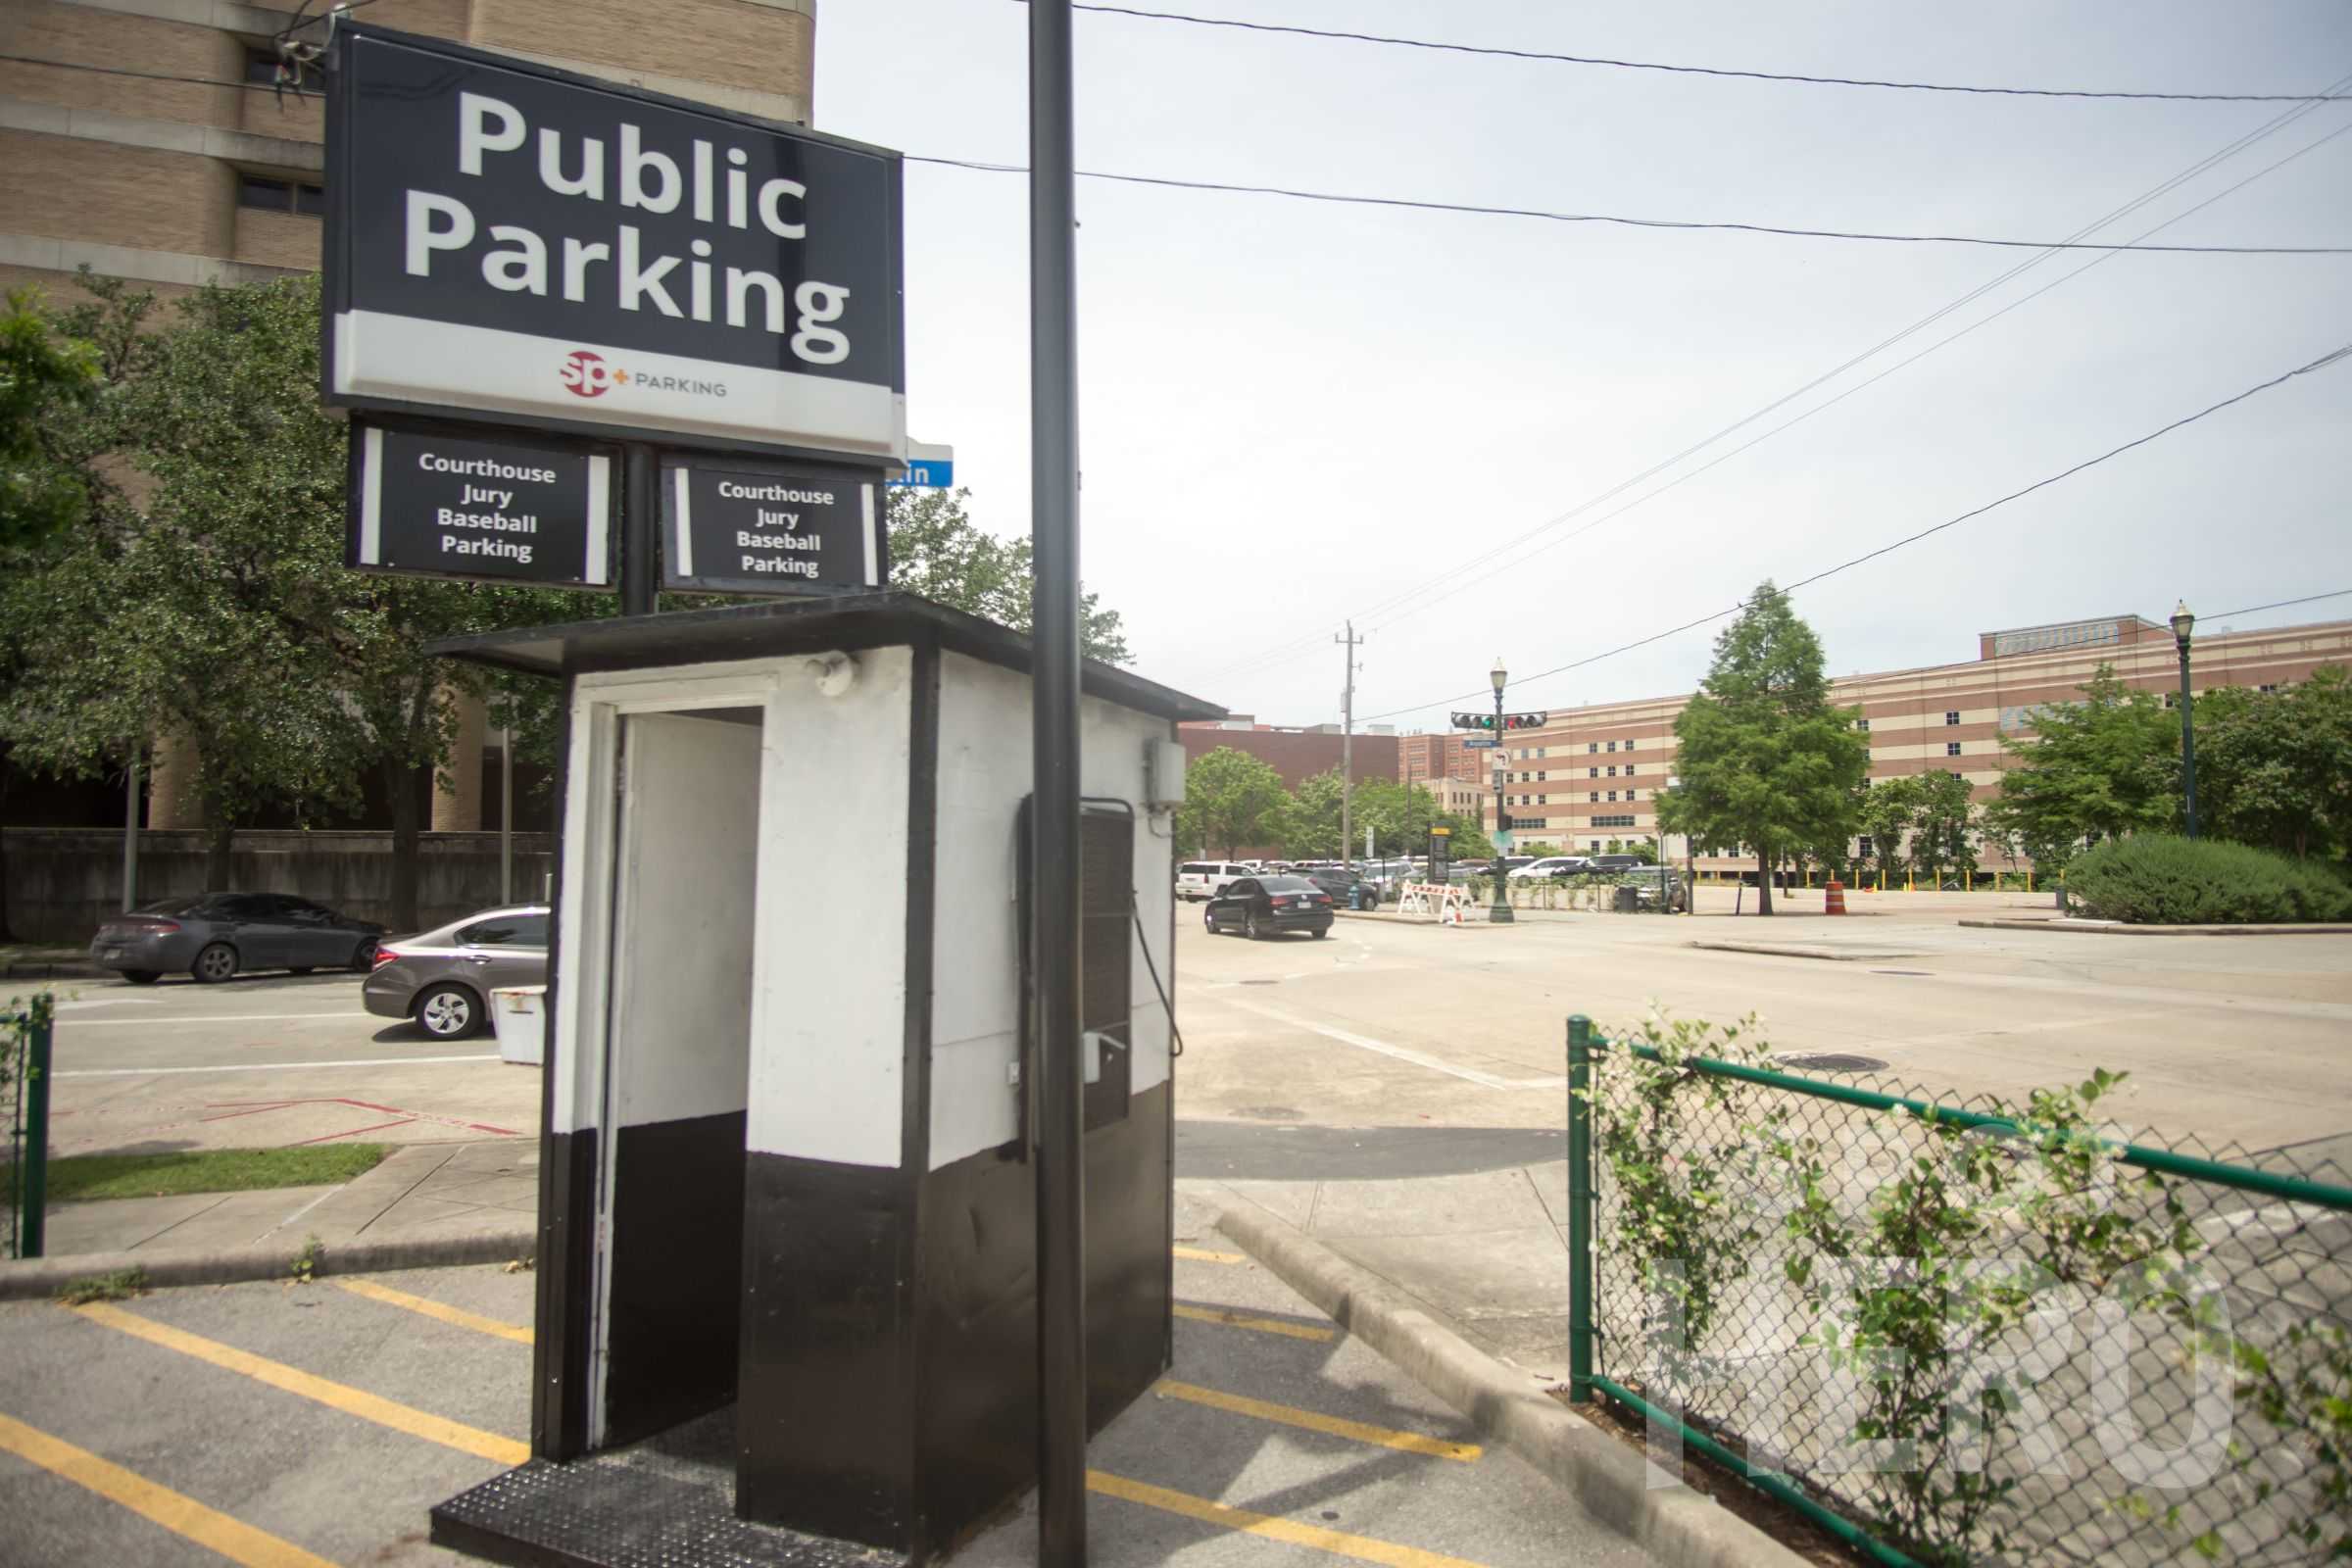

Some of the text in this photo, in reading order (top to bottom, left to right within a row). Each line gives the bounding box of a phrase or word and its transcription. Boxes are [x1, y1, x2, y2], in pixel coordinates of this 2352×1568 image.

[461, 91, 808, 240] Public
[406, 188, 852, 366] Parking
[634, 372, 728, 398] PARKING
[417, 452, 557, 484] Courthouse
[460, 484, 514, 511] Jury
[717, 480, 835, 507] Courthouse
[437, 508, 538, 534] Baseball
[756, 508, 800, 531] Jury
[440, 535, 533, 564] Parking
[736, 530, 821, 552] Baseball
[741, 555, 819, 579] Parking
